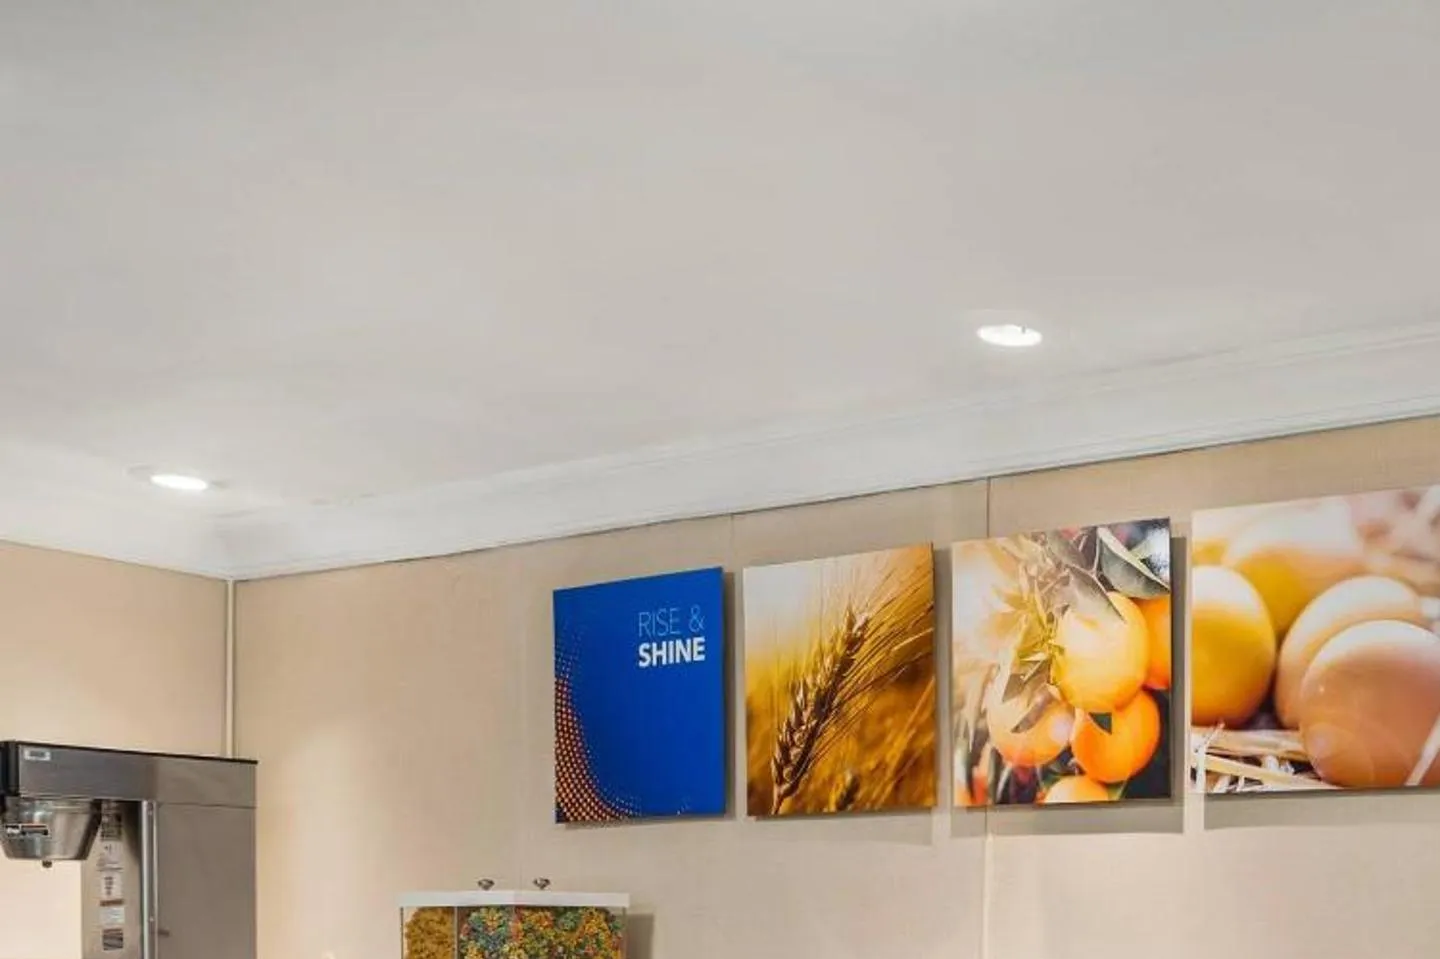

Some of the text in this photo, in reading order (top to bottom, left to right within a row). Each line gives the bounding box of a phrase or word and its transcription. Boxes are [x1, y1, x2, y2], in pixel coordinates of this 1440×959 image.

[638, 604, 705, 639] RISE &
[638, 636, 706, 668] SHINE
